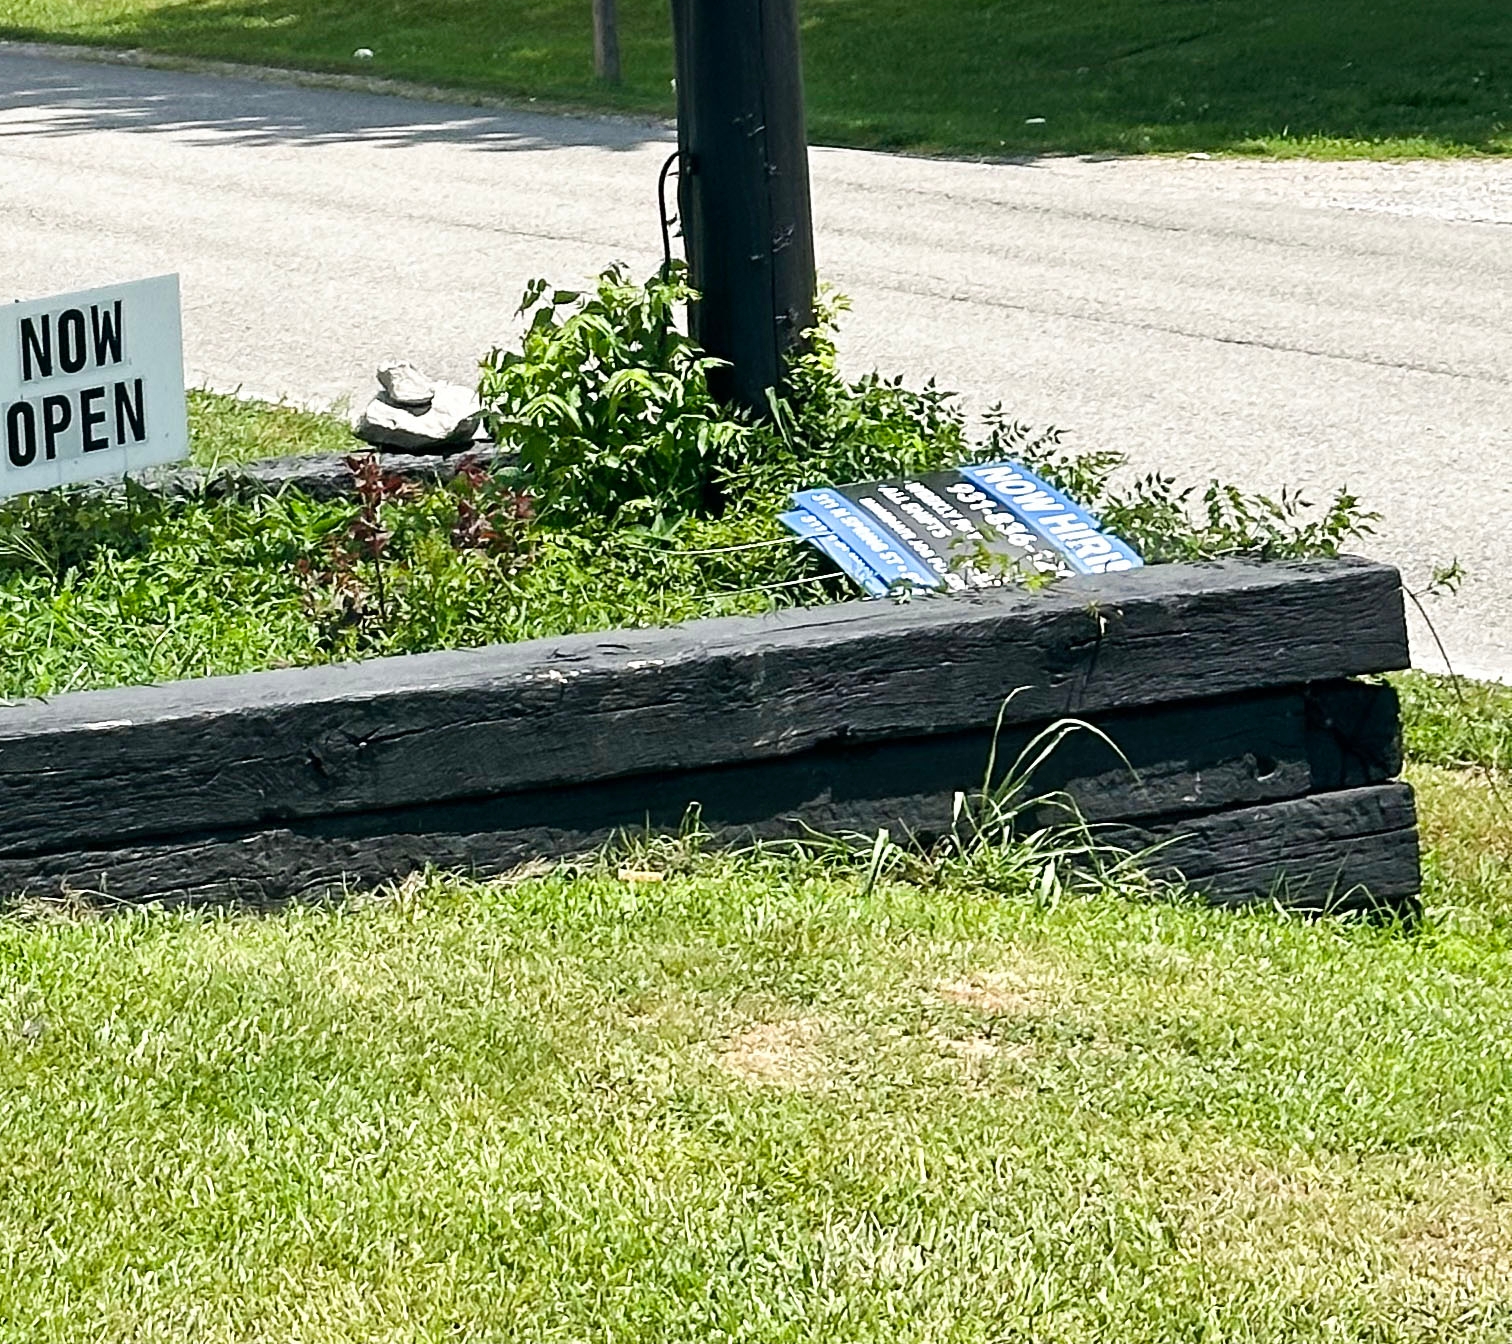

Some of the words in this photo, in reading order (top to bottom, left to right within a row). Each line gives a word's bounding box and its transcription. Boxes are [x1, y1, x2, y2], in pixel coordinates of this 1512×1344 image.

[20, 299, 122, 382] NOW
[6, 378, 146, 467] OPEN
[973, 466, 1065, 512] NOW
